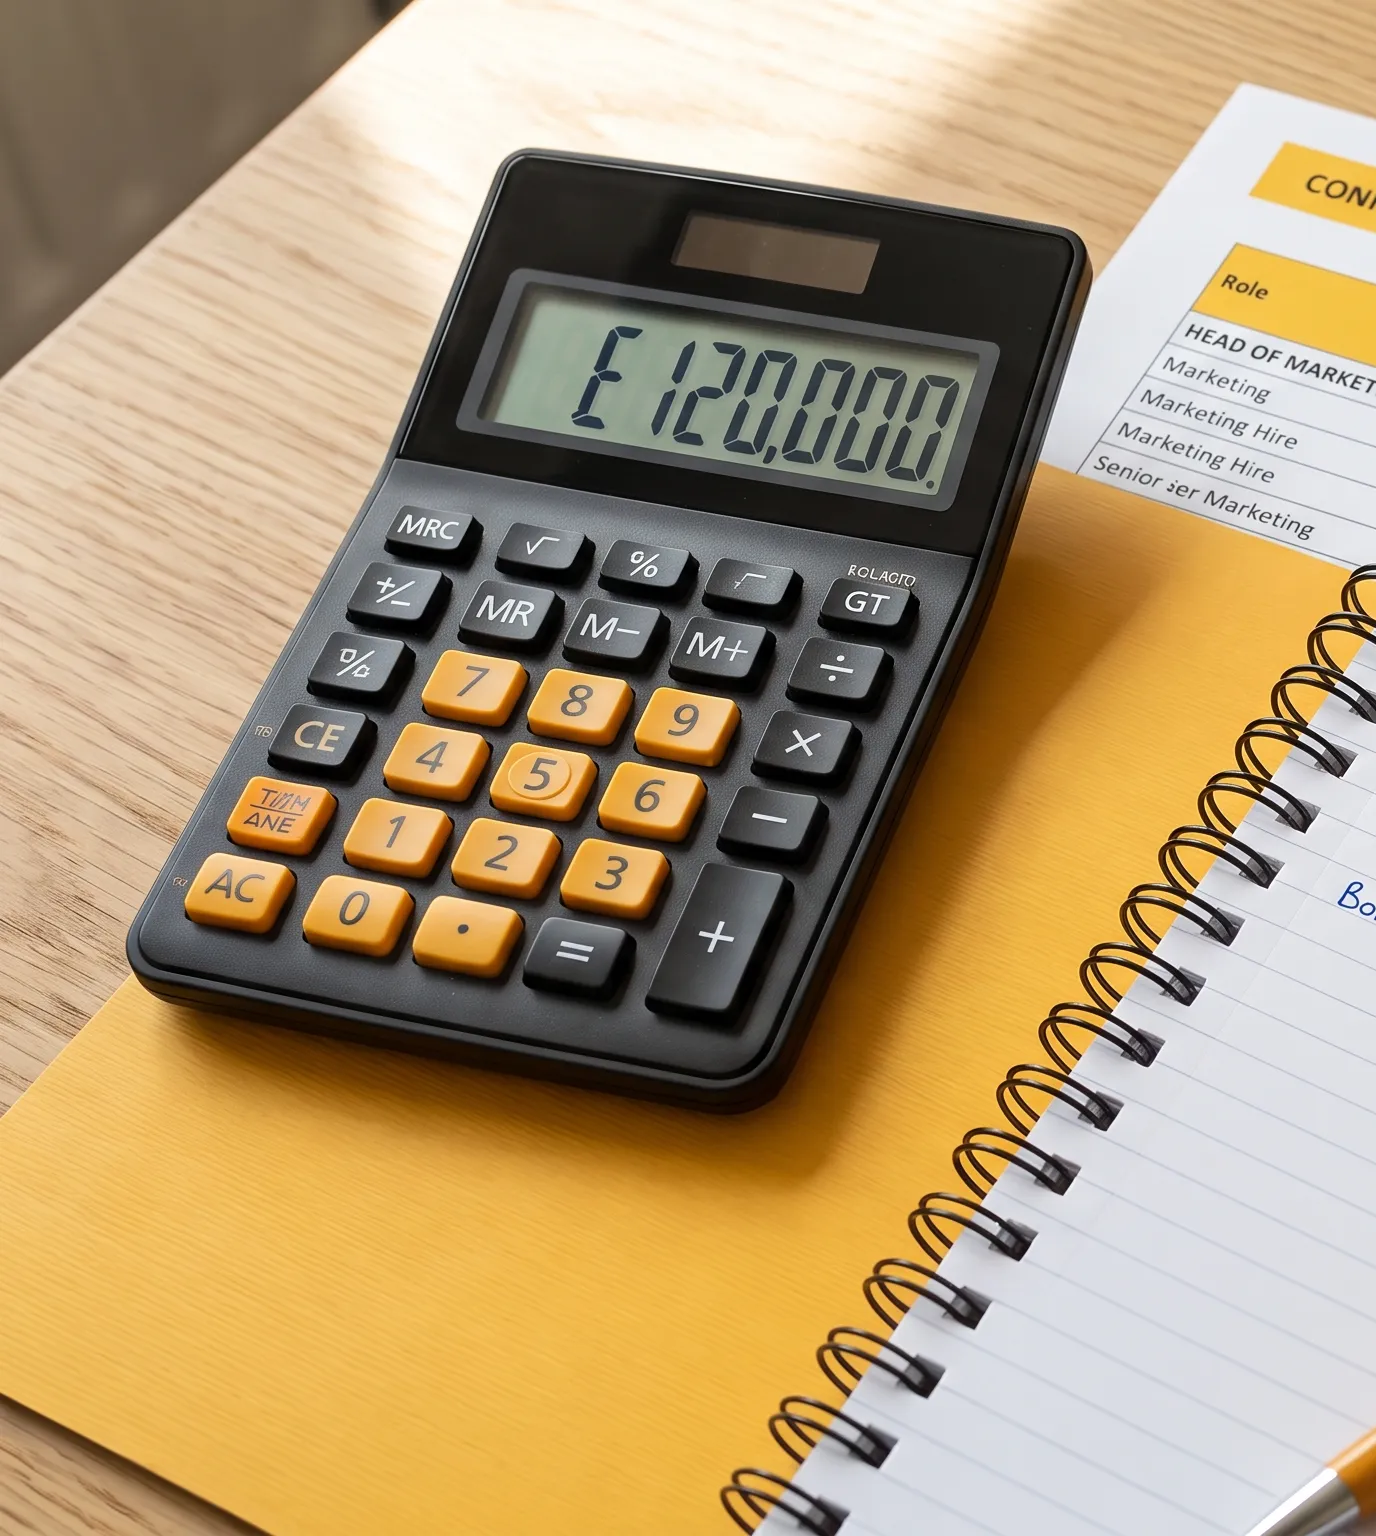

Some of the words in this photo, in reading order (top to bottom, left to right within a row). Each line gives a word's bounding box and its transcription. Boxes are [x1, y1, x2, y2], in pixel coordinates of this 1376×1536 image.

[1220, 273, 1269, 300] Role
[1184, 323, 1247, 353] HEAD
[1250, 344, 1284, 363] OF
[1162, 356, 1272, 405] Marketing
[1139, 389, 1250, 437] Marketing
[1252, 423, 1298, 450] Hire
[1117, 422, 1227, 471] Marketing
[1229, 457, 1275, 484] Hire
[1093, 455, 1164, 488] Senior
[1203, 489, 1316, 541] Marketing
[396, 513, 460, 541] MRC
[475, 594, 535, 627] MR
[844, 590, 891, 616] GT
[685, 631, 749, 664] M+
[456, 664, 491, 698] 7
[559, 683, 594, 718] 8
[293, 720, 346, 753] CE
[669, 704, 700, 738] 9
[415, 741, 448, 774] 4
[522, 757, 553, 792] 5
[633, 778, 666, 814] 6
[243, 811, 297, 834] ANE
[385, 816, 405, 850] 1
[483, 835, 519, 872] 2
[204, 868, 266, 903] AC
[594, 854, 629, 892] 3
[339, 890, 370, 927] 0
